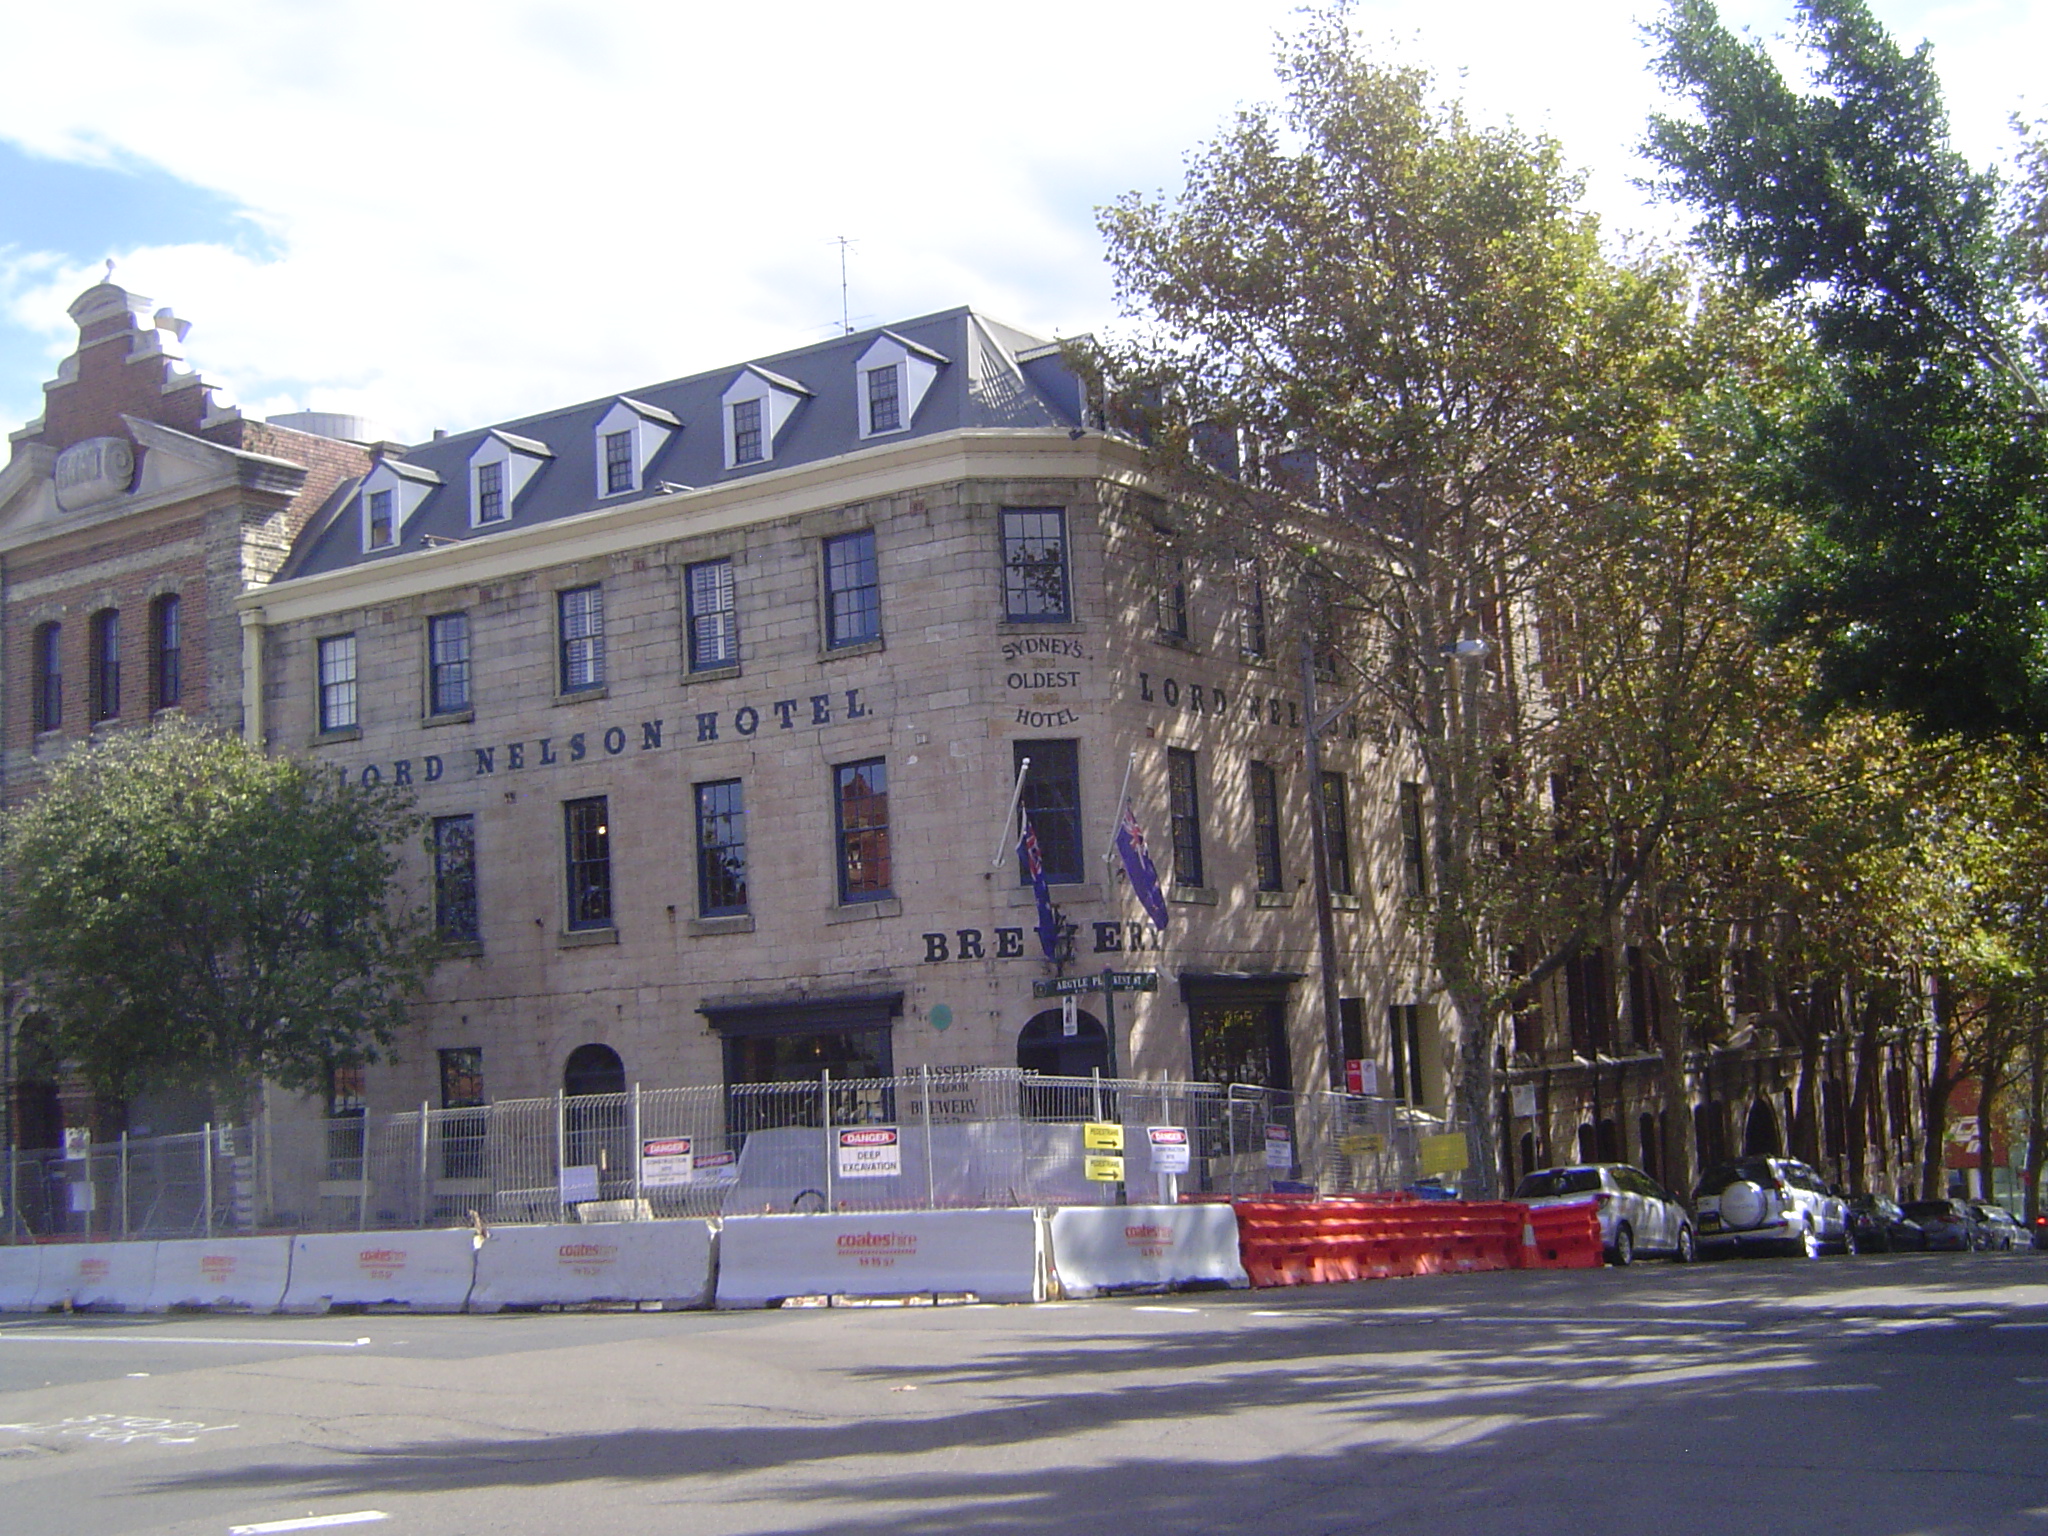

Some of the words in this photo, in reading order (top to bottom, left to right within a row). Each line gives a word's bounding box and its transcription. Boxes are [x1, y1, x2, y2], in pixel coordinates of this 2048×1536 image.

[1001, 636, 1083, 661] SYDNEY'S
[1007, 671, 1080, 689] OLDEST
[1139, 671, 1228, 716] LORD
[1015, 708, 1079, 727] HOTEL
[339, 755, 444, 788] LORD
[476, 719, 664, 775] NELSON
[1056, 977, 1089, 991] ARGYLE
[847, 1132, 890, 1143] DANGER
[649, 1142, 684, 1154] DANGER
[857, 1150, 881, 1161] DEEP
[842, 1161, 897, 1173] EXCAVATION
